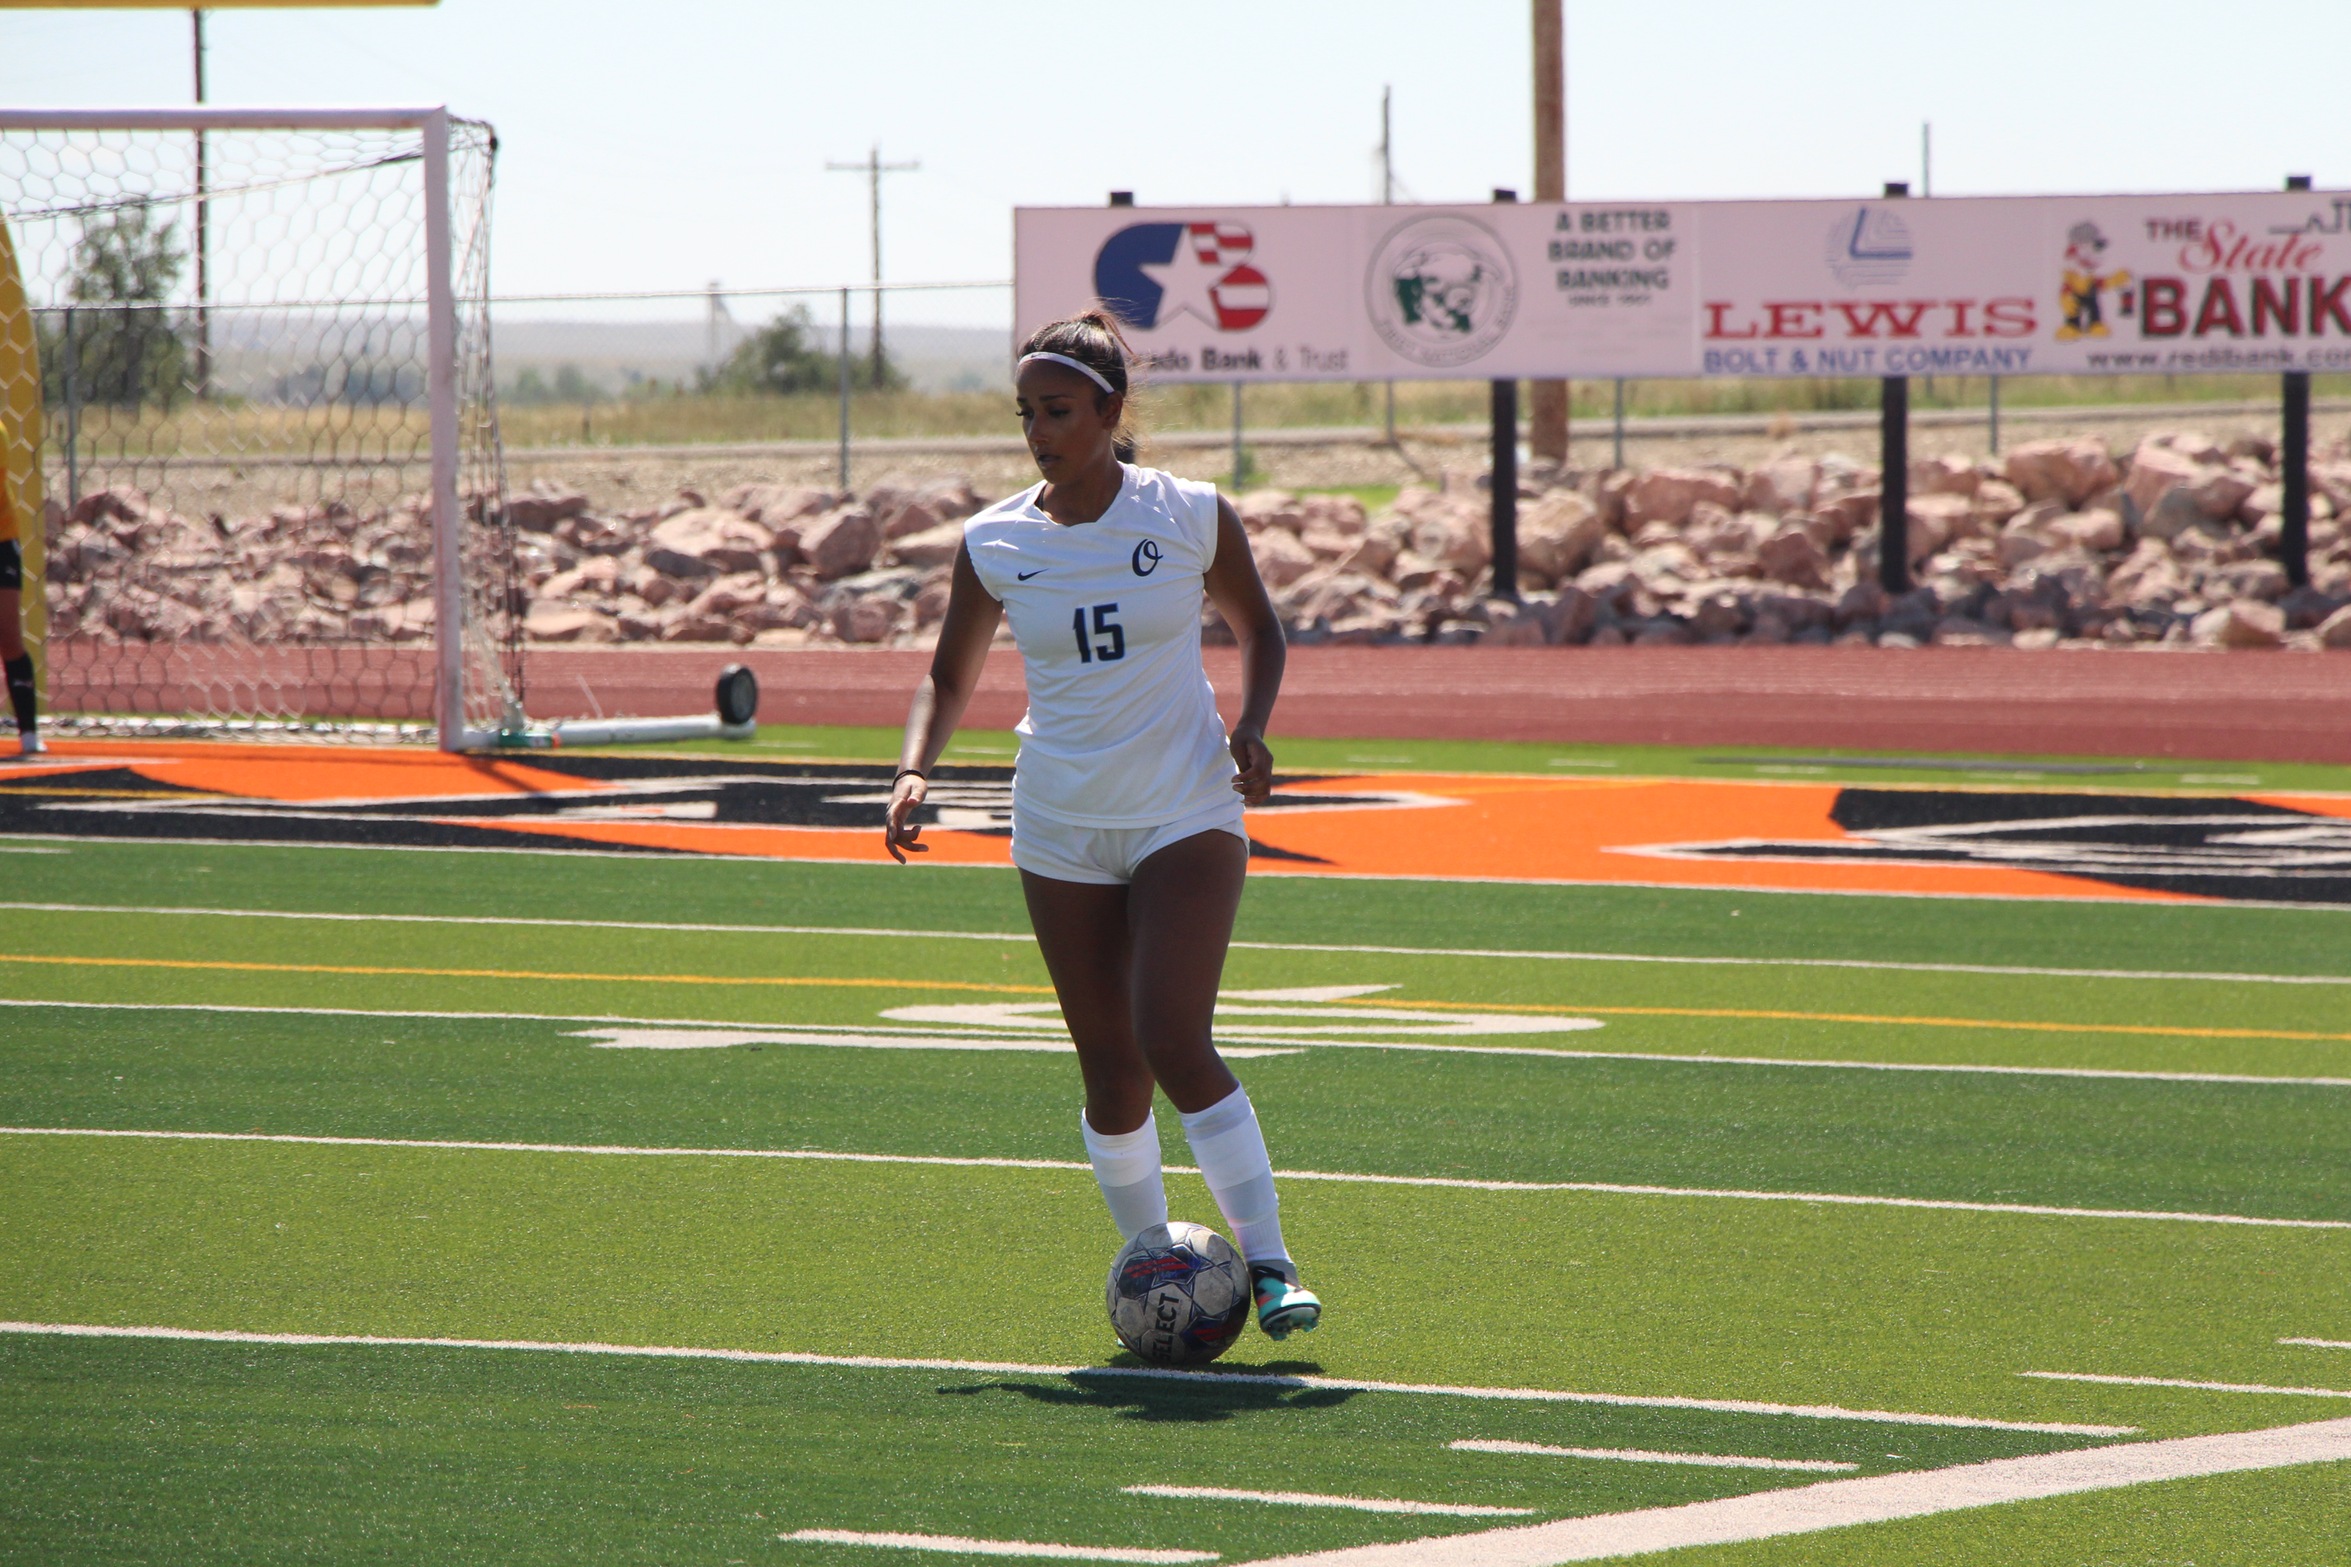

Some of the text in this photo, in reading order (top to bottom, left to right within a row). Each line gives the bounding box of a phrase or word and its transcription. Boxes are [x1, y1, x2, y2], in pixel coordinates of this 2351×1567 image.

[1555, 210, 1671, 232] A BETTER
[2145, 218, 2203, 241] THE
[1548, 238, 1676, 262] BRAND OF
[2178, 218, 2322, 275] State
[1556, 268, 1669, 291] BANKING
[1703, 297, 2038, 340] LEWIS
[2140, 274, 2351, 339] BANK
[1201, 347, 1262, 372] Bank
[1273, 348, 1289, 371] &
[1299, 346, 1349, 372] Trust
[1703, 344, 2033, 374] BOLT & NUT COMPANY
[1073, 602, 1125, 663] 15
